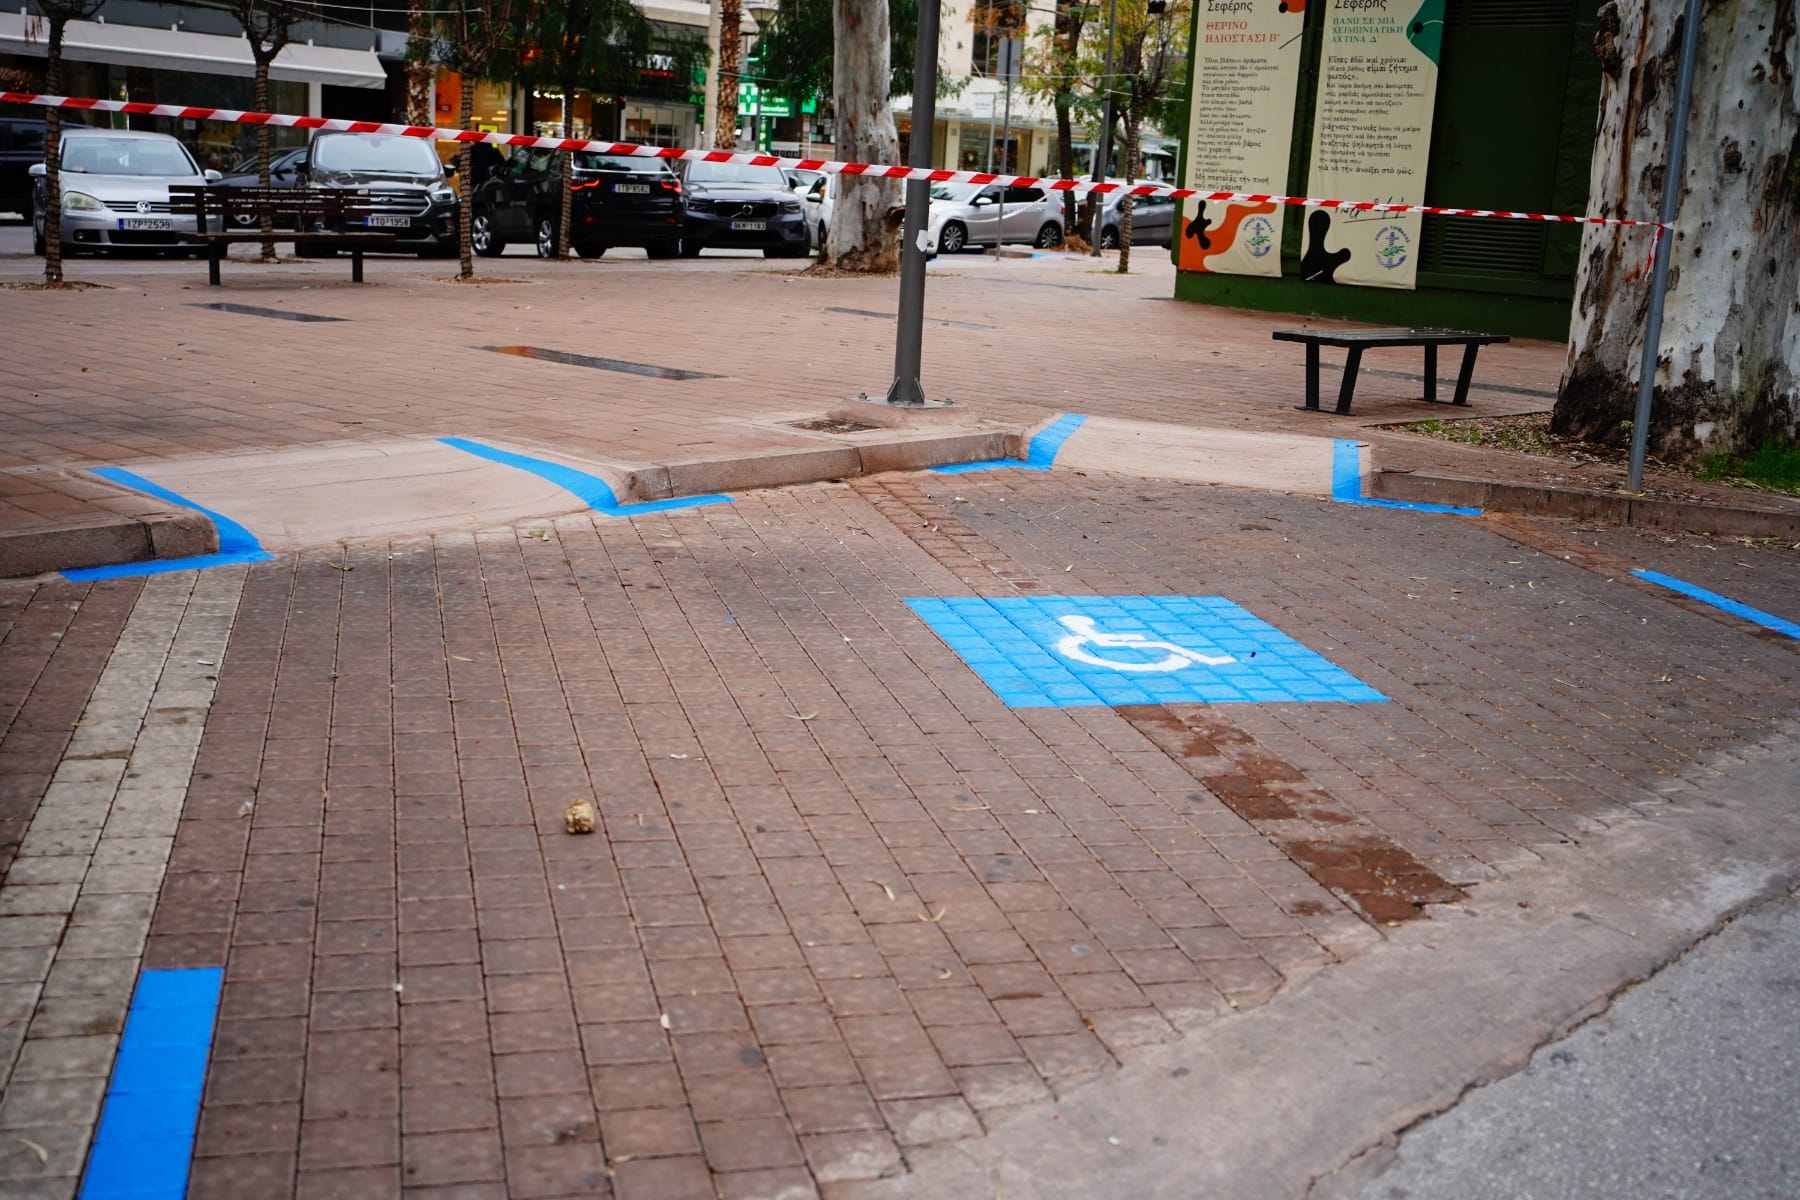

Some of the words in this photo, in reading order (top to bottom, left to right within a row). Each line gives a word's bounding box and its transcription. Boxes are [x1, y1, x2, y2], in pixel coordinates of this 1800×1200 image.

[1333, 17, 1360, 25] ΠΑΝΩ
[1362, 17, 1375, 25] ΣΕ
[1377, 16, 1395, 25] ΜΙΑ
[1206, 21, 1248, 31] ΘΕΡΙΝΟ
[1205, 34, 1266, 43] ΗΛΙΟΣΤΑΣΙ
